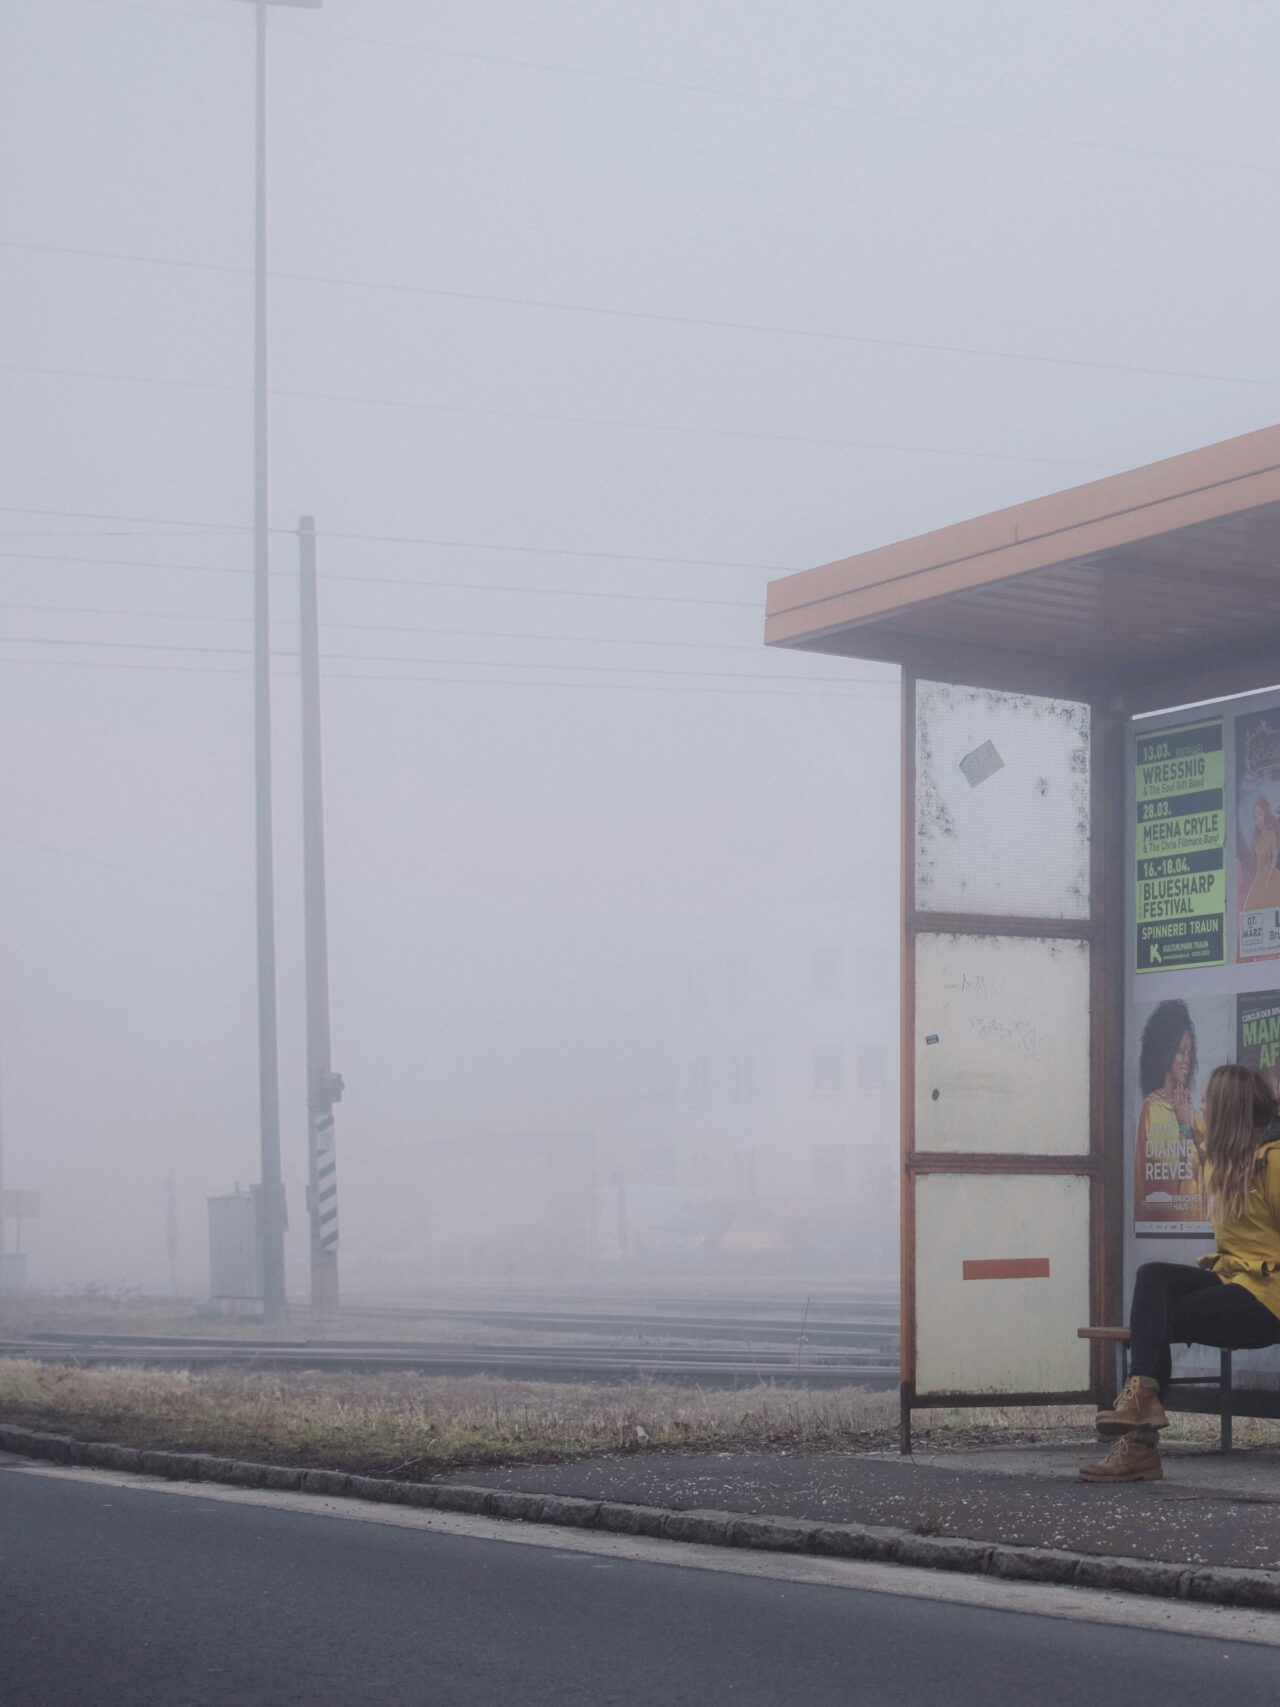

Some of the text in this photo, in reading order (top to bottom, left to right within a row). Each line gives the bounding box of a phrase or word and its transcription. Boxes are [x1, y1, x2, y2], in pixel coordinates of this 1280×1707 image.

[1143, 743, 1171, 761] 13.03.
[1143, 757, 1205, 785] WRESSNIG
[1150, 785, 1160, 795] The
[1161, 783, 1175, 794] Soul
[1189, 779, 1204, 789] Band
[1143, 801, 1171, 820] 28.03.
[1143, 814, 1219, 843] MEENA CRYLE
[1149, 842, 1160, 852] The
[1161, 839, 1177, 851] Chris
[1204, 832, 1219, 843] Band
[1144, 857, 1191, 878] 16.-18.04.
[1143, 874, 1215, 901] BLUESHARP
[1143, 897, 1194, 919] FESTIVAL
[1142, 919, 1219, 941] SPINNEREI TRAUN
[1247, 916, 1257, 926] 07.
[1243, 925, 1262, 938] MÄRZ
[1145, 1139, 1194, 1158] DIANNE
[1145, 1162, 1194, 1181] REEVES
